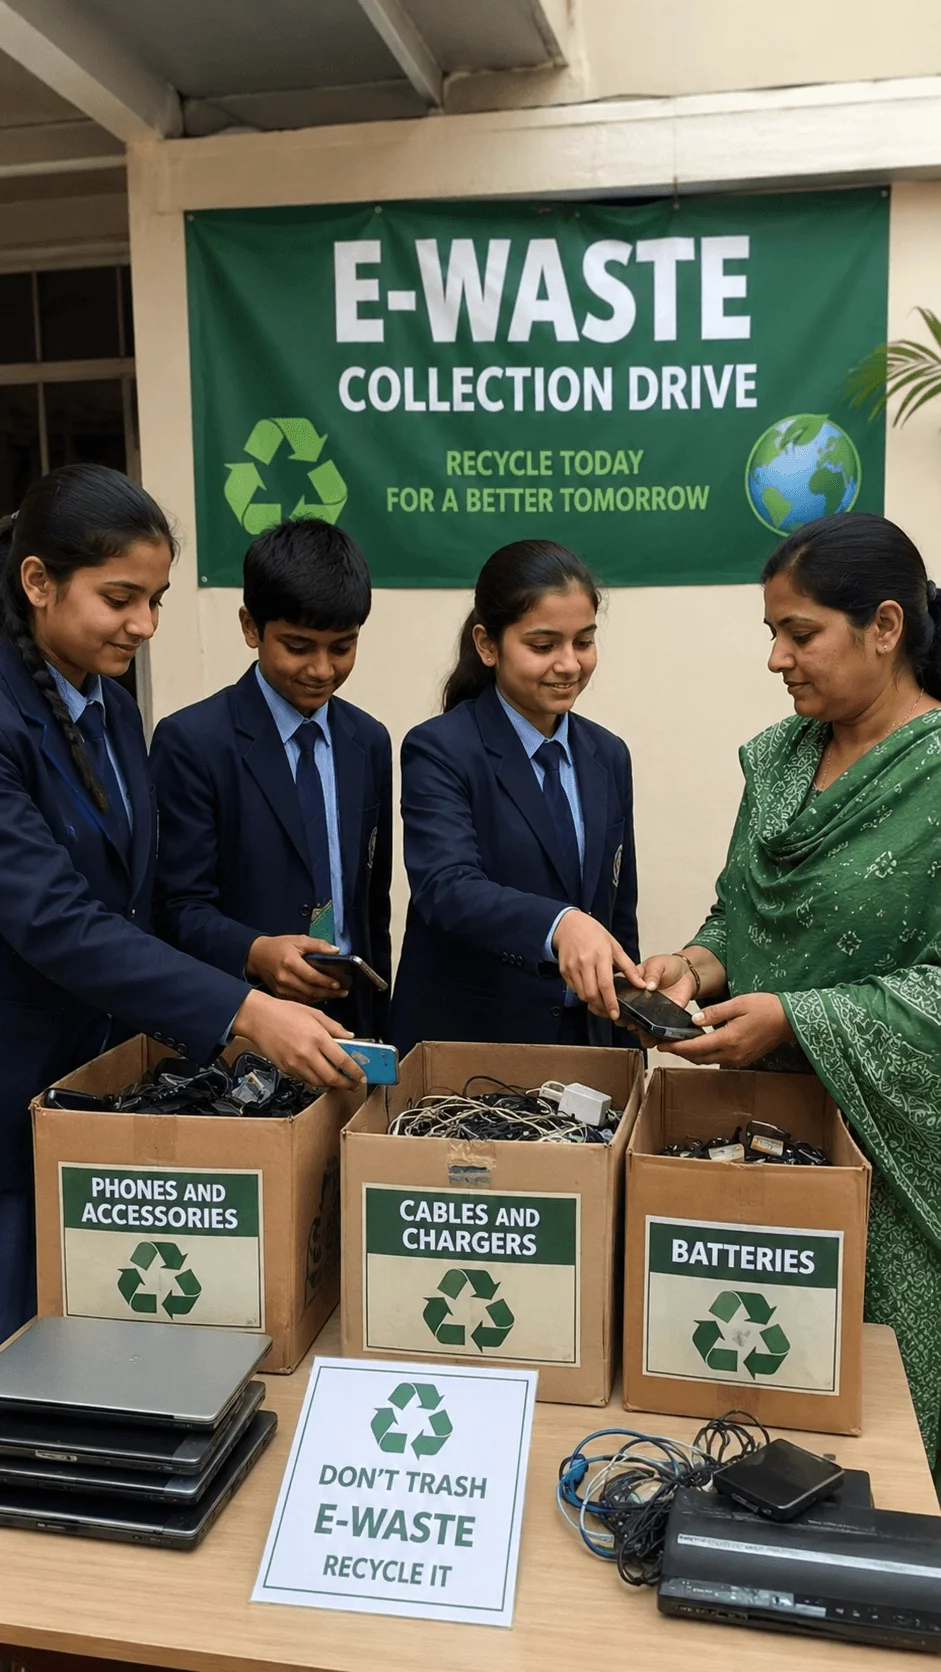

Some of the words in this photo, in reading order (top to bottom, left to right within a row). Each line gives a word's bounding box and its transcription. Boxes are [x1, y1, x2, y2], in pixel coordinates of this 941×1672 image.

[335, 236, 750, 343] E-WASTE
[339, 367, 612, 412] COLLECTION
[629, 364, 757, 410] DRIVE
[447, 451, 552, 475] RECYCLE
[560, 450, 643, 475] TODAY
[387, 488, 434, 512] FOR
[442, 488, 458, 512] A
[467, 488, 553, 512] BETTER
[560, 486, 709, 512] TOMORROW
[92, 1178, 177, 1200] PHONES
[184, 1184, 225, 1202] AND
[82, 1203, 238, 1229] ACCESSORIES
[400, 1200, 488, 1225] CABLES
[495, 1208, 539, 1227] AND
[403, 1228, 536, 1255] CHARGERS
[672, 1239, 814, 1274] BATTERIES
[319, 1465, 399, 1490] DON'T
[406, 1471, 487, 1498] TRASH
[314, 1503, 475, 1547] E-WASTE
[323, 1555, 424, 1585] RECYCLE
[430, 1565, 452, 1587] IT
